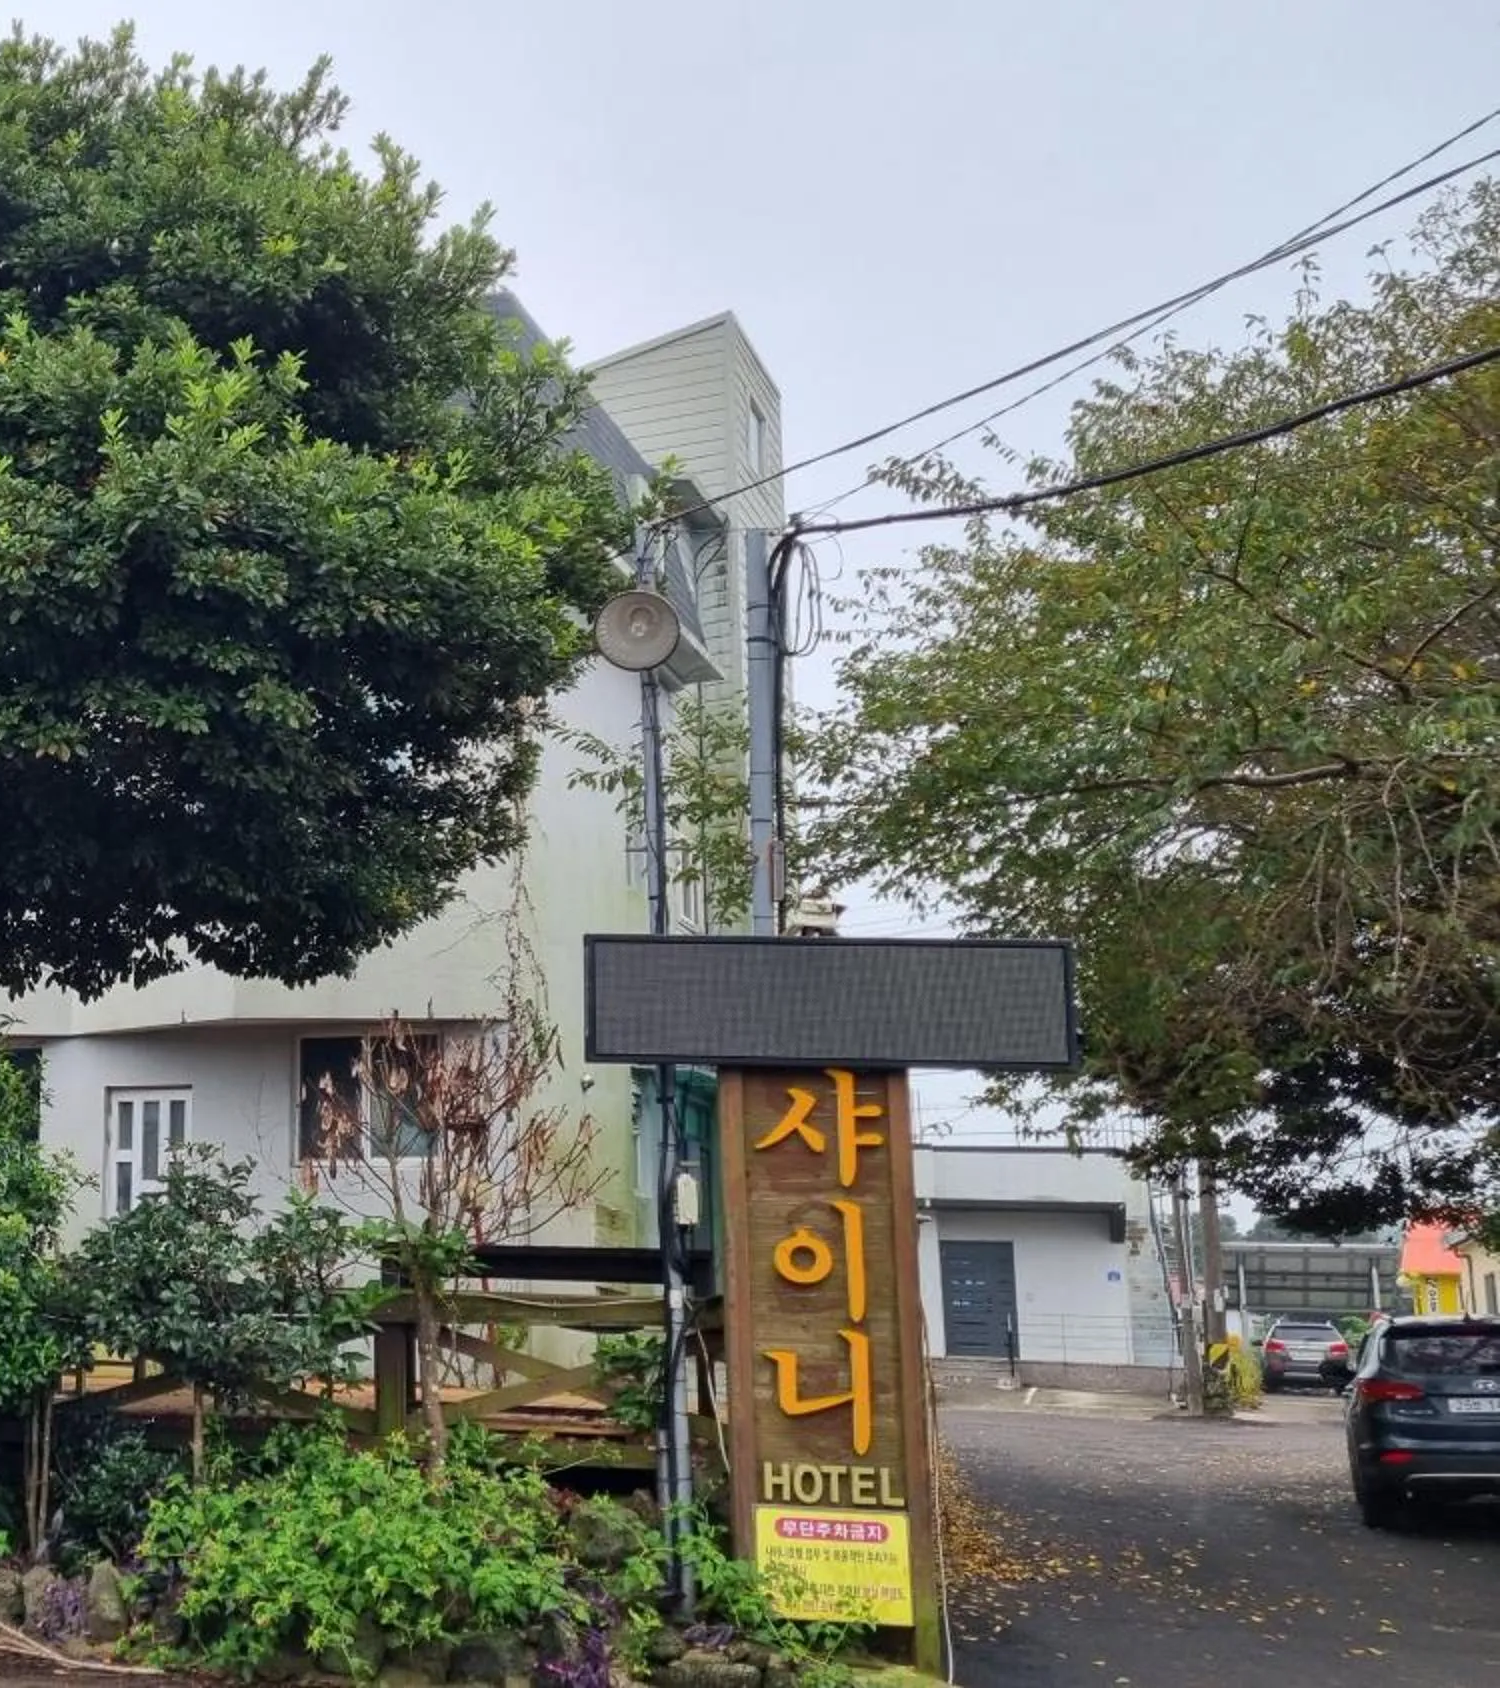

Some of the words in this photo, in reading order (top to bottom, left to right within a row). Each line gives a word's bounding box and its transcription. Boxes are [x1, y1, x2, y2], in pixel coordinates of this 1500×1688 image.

[754, 1069, 886, 1457] 샤이니
[763, 1460, 906, 1507] HOTEL
[782, 1518, 883, 1541] 무단주차금지
